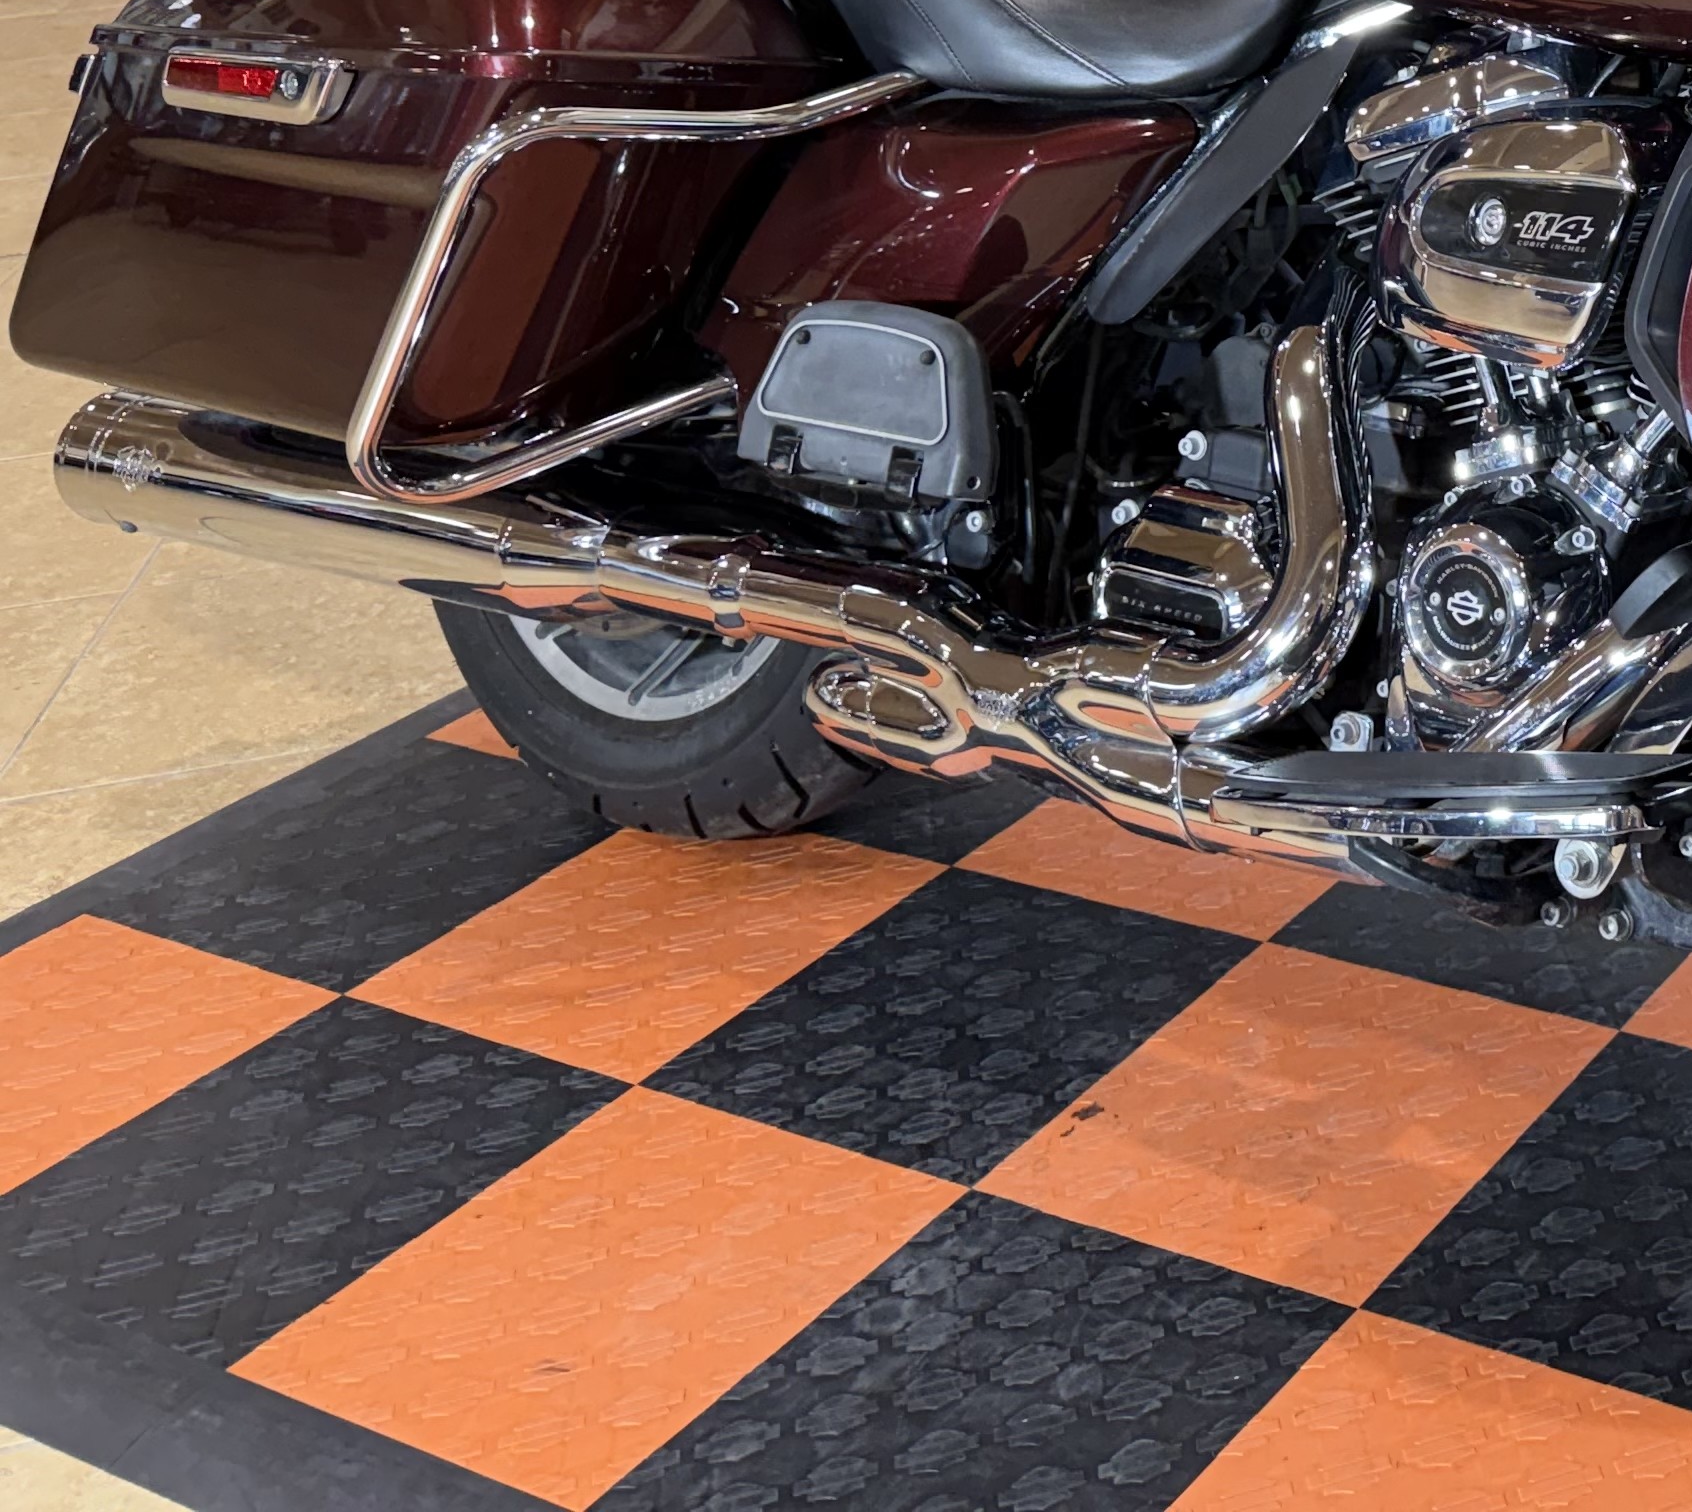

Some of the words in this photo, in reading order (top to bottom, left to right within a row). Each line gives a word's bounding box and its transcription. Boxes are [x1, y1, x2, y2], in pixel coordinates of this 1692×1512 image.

[1519, 211, 1594, 244] 114
[1516, 239, 1546, 249] CUBIC
[1550, 243, 1587, 254] INCHES
